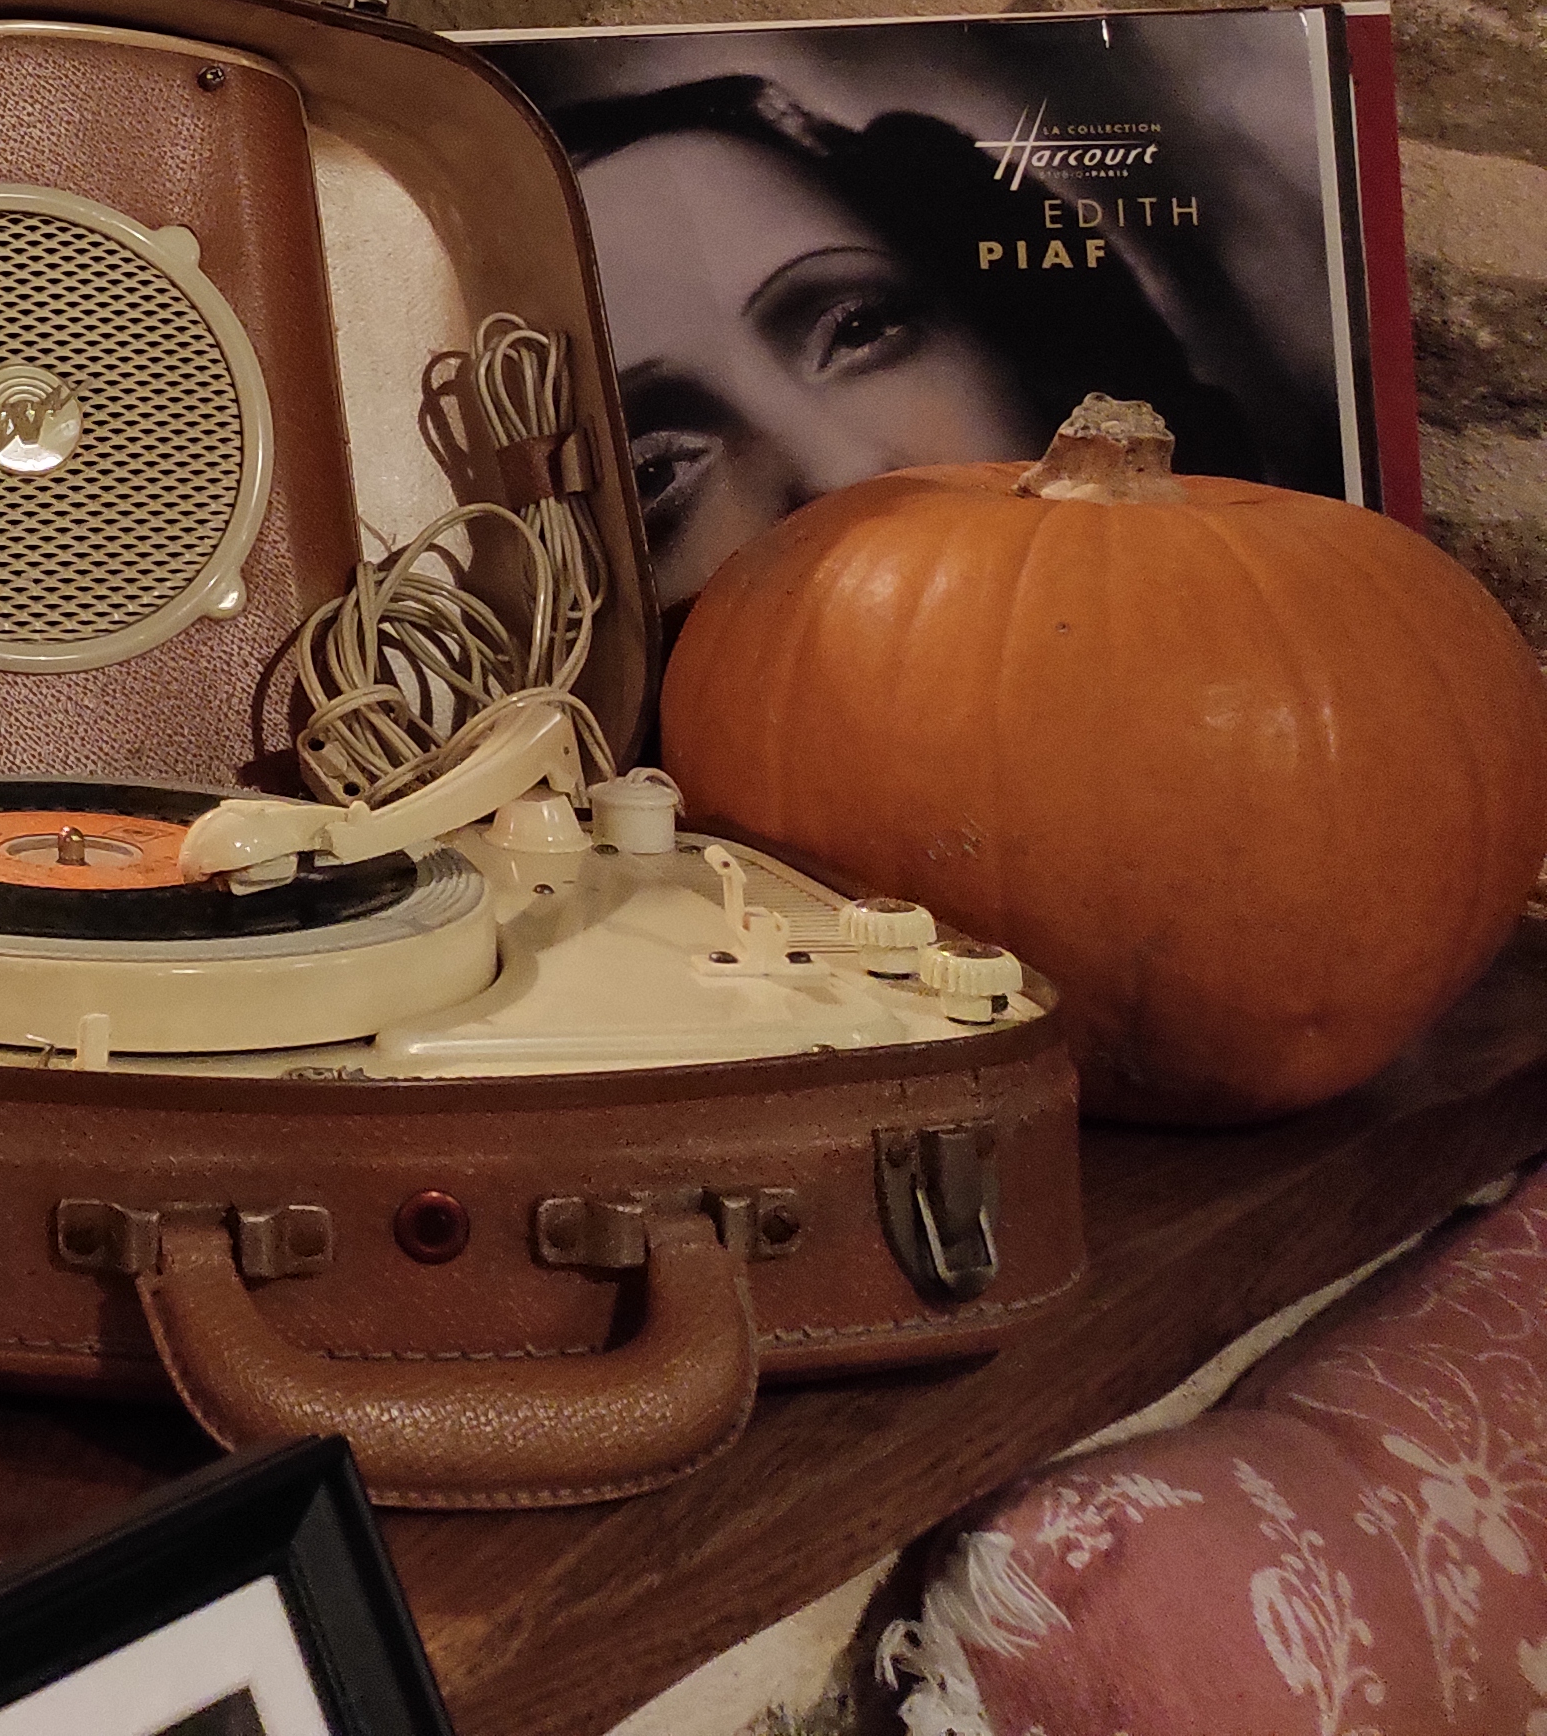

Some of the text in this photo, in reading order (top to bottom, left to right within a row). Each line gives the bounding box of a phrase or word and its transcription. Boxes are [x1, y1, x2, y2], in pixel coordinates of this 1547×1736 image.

[974, 98, 1158, 191] Harcourt
[1043, 123, 1161, 136] LA COLLECTION
[1044, 197, 1199, 229] EDITH
[978, 239, 1106, 270] PIAF
